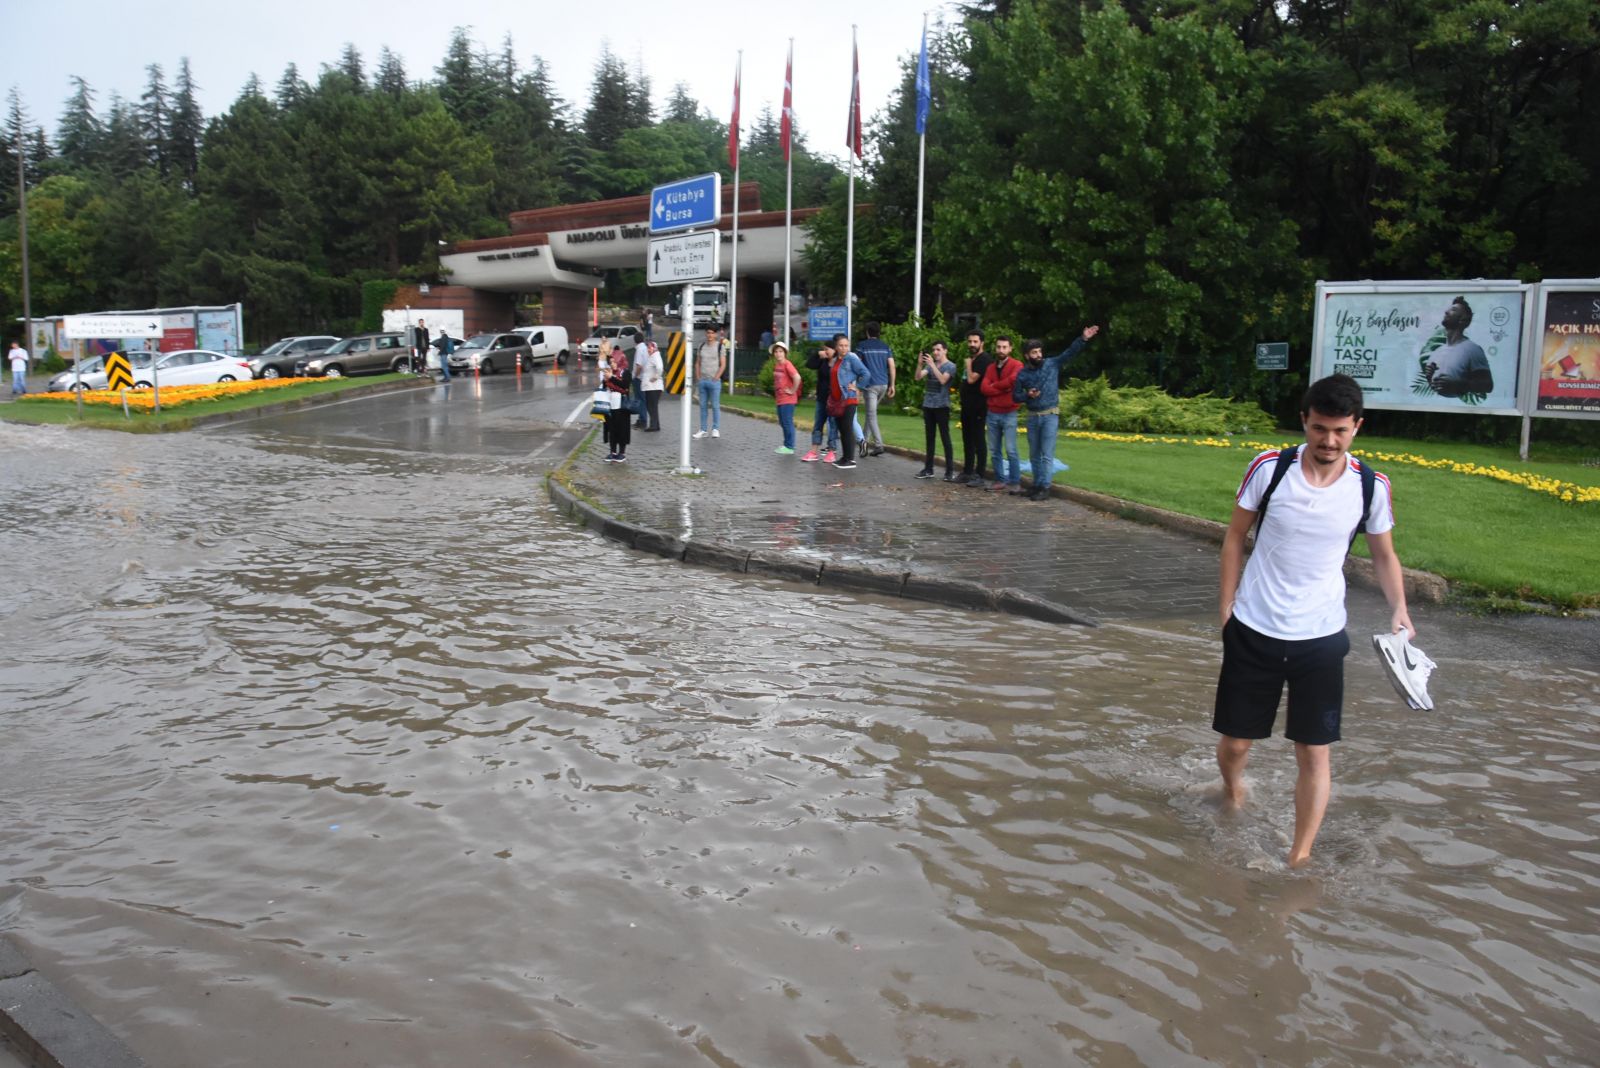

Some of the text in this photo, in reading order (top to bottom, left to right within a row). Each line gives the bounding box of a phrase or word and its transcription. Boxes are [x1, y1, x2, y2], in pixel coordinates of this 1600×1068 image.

[666, 188, 705, 204] Kütahya
[665, 208, 693, 222] Bursa
[566, 230, 616, 243] ANADOLU
[689, 252, 704, 262] Emre
[1335, 308, 1420, 336] Yaz Başlasın
[1335, 335, 1365, 347] TAN
[1334, 348, 1377, 364] TAŞÇI
